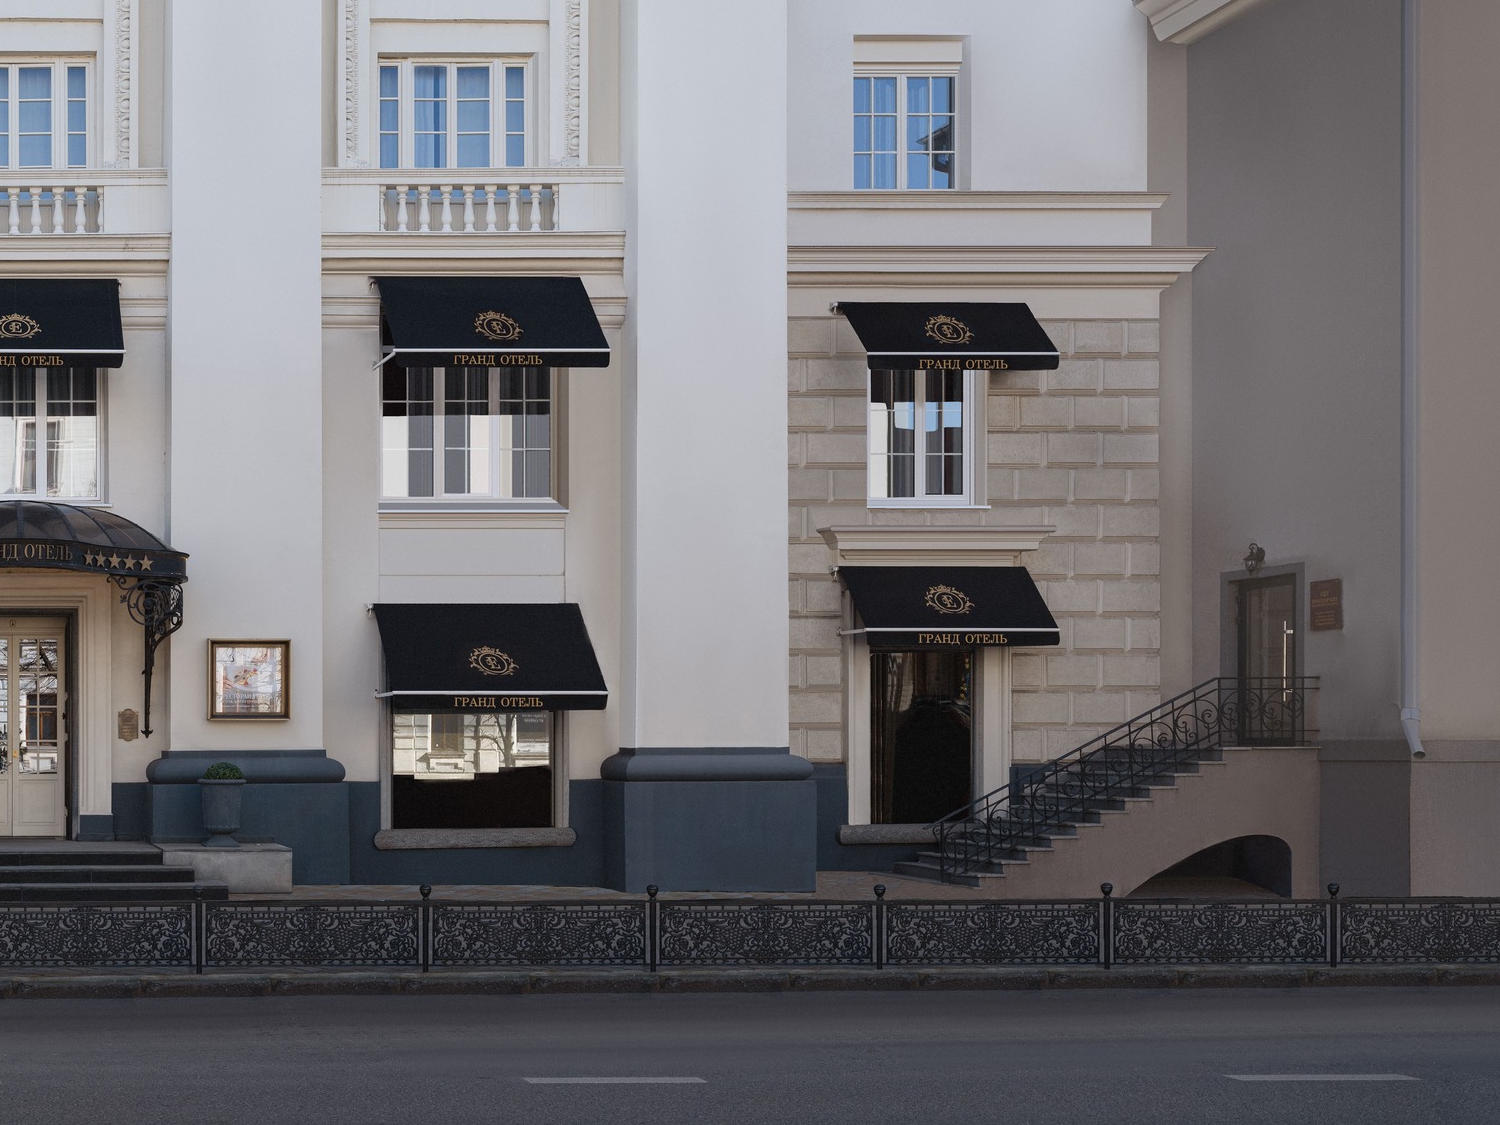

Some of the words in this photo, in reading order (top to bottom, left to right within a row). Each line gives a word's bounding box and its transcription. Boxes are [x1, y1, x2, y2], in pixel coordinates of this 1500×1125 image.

[21, 355, 64, 365] ОТЕЛЬ
[453, 355, 495, 366] ГРАНД
[500, 354, 543, 365] ОТЕЛЬ
[919, 359, 961, 370] ГРАНД
[965, 359, 1008, 369] ОТЕЛЬ
[24, 543, 73, 561] ОТЕЛЬ
[918, 634, 960, 645] ГРАНД
[965, 634, 1008, 644] ОТЕЛЬ
[454, 697, 496, 708] ГРАНД
[501, 697, 543, 707] ОТЕЛЬ
